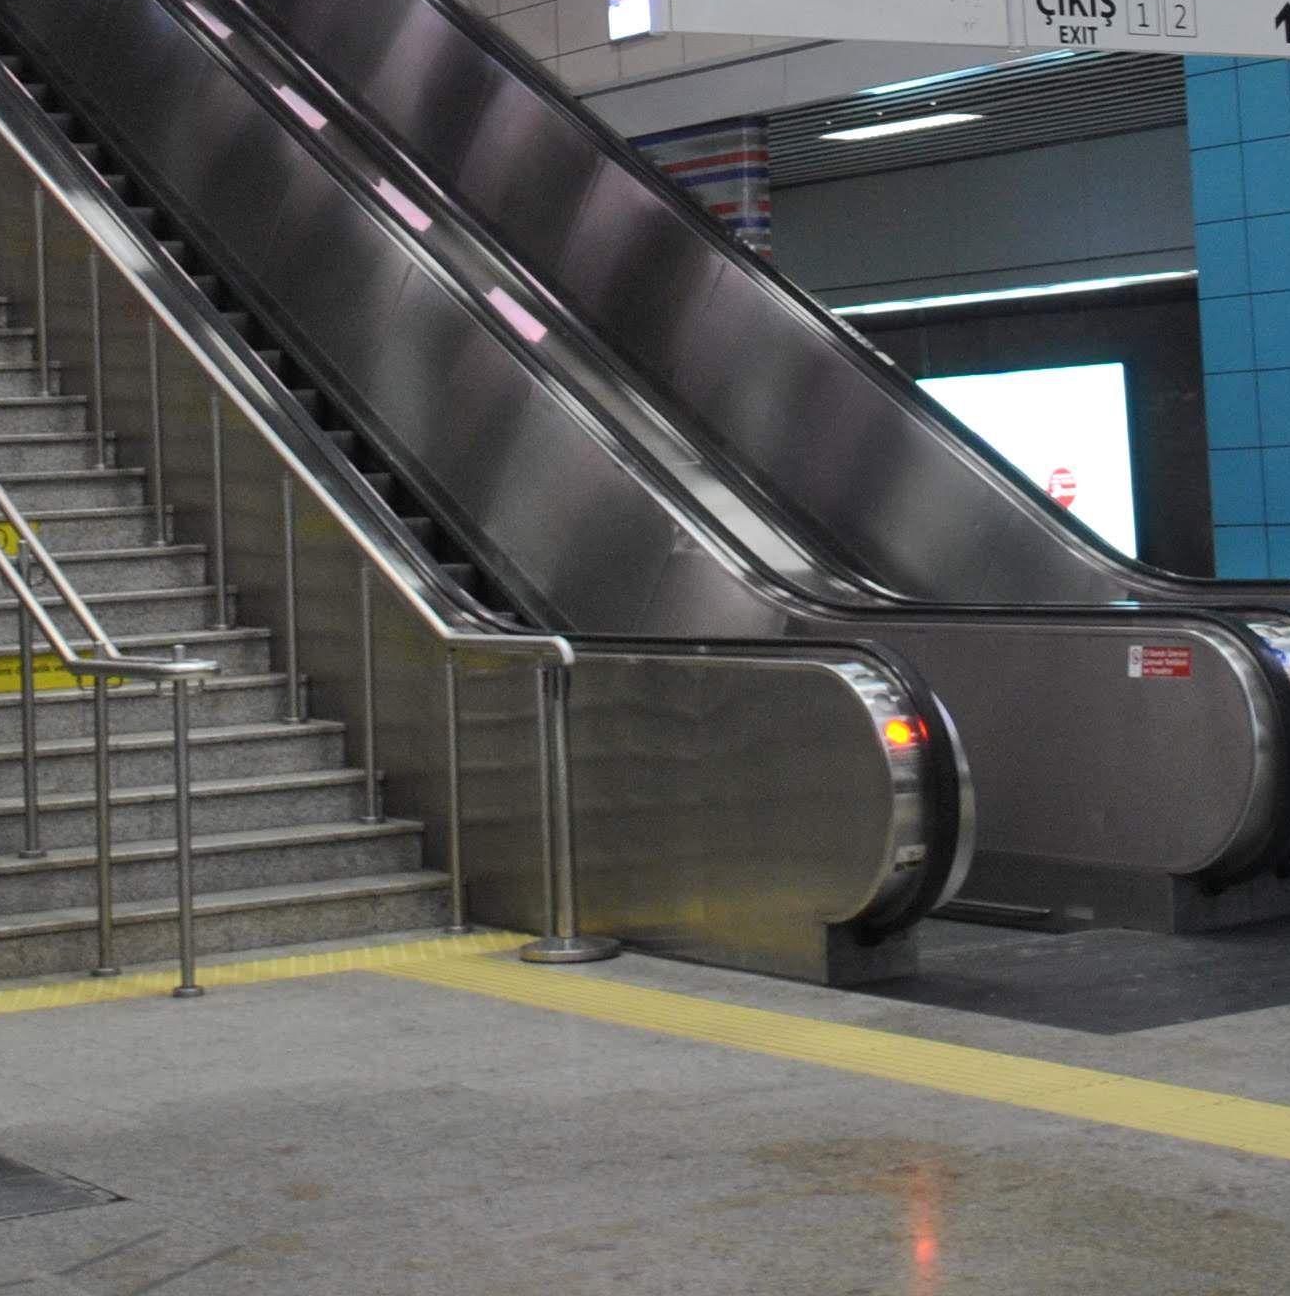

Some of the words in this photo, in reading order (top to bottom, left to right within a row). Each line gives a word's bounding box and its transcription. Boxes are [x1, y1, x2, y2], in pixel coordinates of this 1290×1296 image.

[1137, 2, 1150, 28] 1
[1174, 4, 1187, 29] 2
[1059, 25, 1098, 45] EXIT
